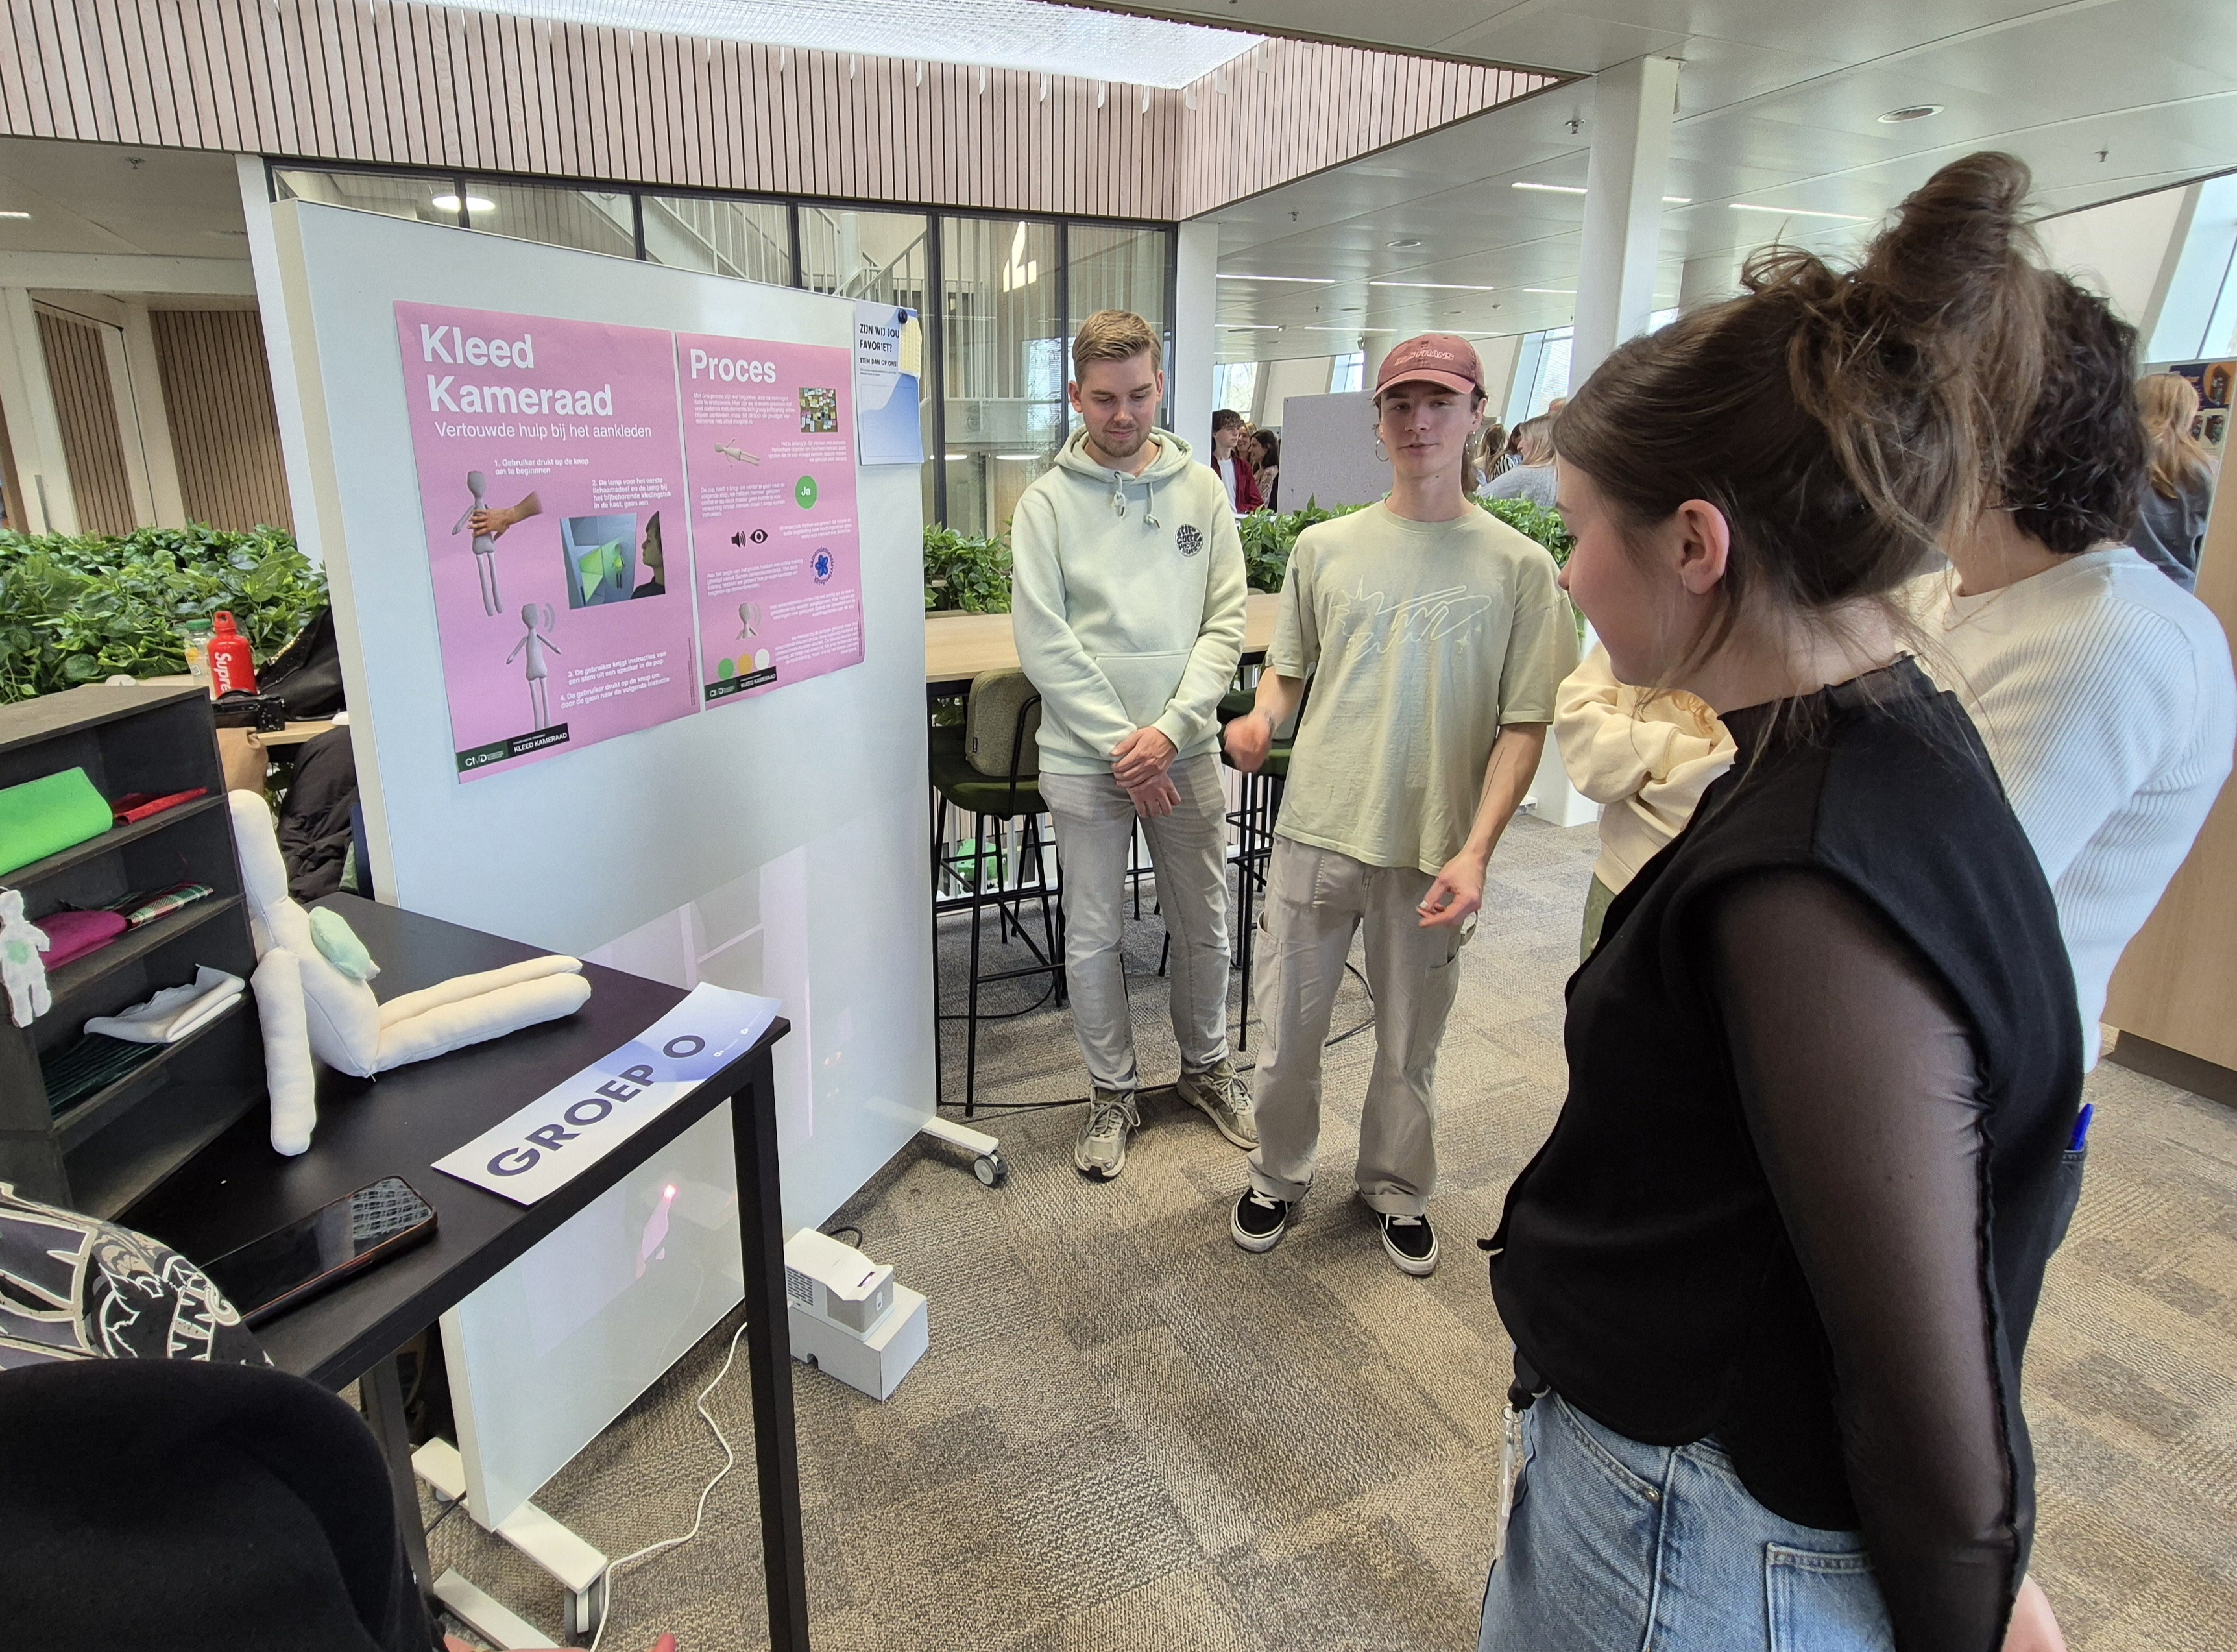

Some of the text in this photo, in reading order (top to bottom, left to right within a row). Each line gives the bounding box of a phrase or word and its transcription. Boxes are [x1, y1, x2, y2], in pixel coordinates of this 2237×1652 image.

[860, 324, 899, 338] ZIJN WIJ JOU
[420, 324, 534, 369] Kleed
[860, 339, 892, 352] FAVORIET?
[690, 348, 776, 383] Proces
[427, 374, 613, 416] Kameraad
[435, 421, 651, 441] Vertouwde hulp bij het aankleden
[801, 486, 810, 496] Ja
[1177, 524, 1196, 537] RIP
[1177, 533, 1202, 544] CURL
[213, 651, 232, 692] Supre
[585, 664, 611, 675] gebruiker
[617, 664, 638, 674] speaker
[577, 686, 604, 699] gebruiker
[465, 754, 487, 766] CMD
[514, 742, 533, 753] KLEED
[535, 733, 567, 746] KAMERAAD
[487, 1035, 705, 1176] GROEP O
